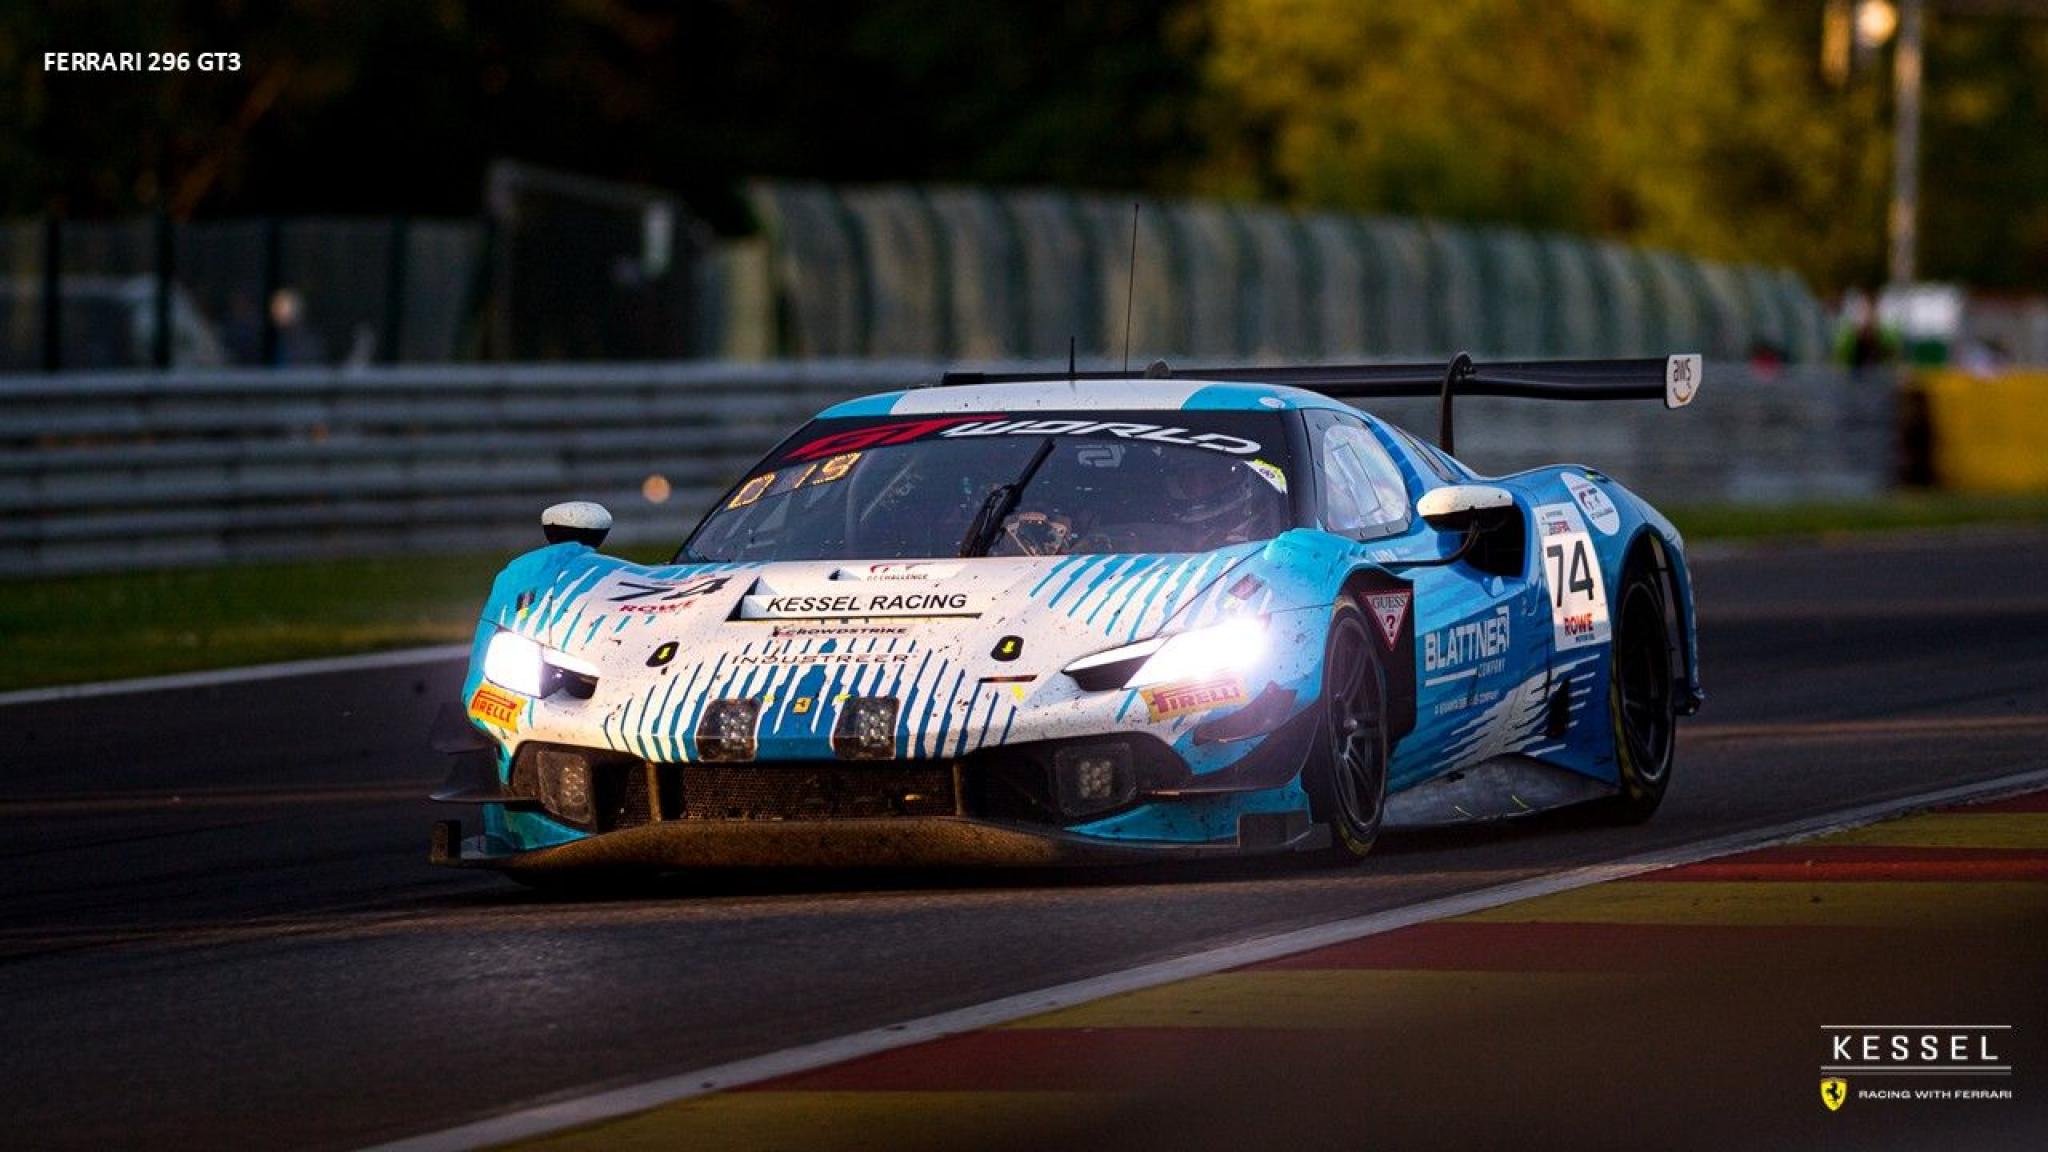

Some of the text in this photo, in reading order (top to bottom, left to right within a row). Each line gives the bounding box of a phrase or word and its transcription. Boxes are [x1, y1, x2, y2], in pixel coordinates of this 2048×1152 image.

[940, 420, 1262, 454] WORLD
[607, 574, 736, 601] 74
[1546, 540, 1594, 608] 74
[767, 594, 968, 613] KESSEL RACING
[1371, 595, 1408, 609] GUESS
[1425, 606, 1510, 672] BLATTNER
[1564, 612, 1594, 635] ROWE
[471, 689, 516, 723] PIRELLI
[1152, 680, 1241, 713] PIRELLI
